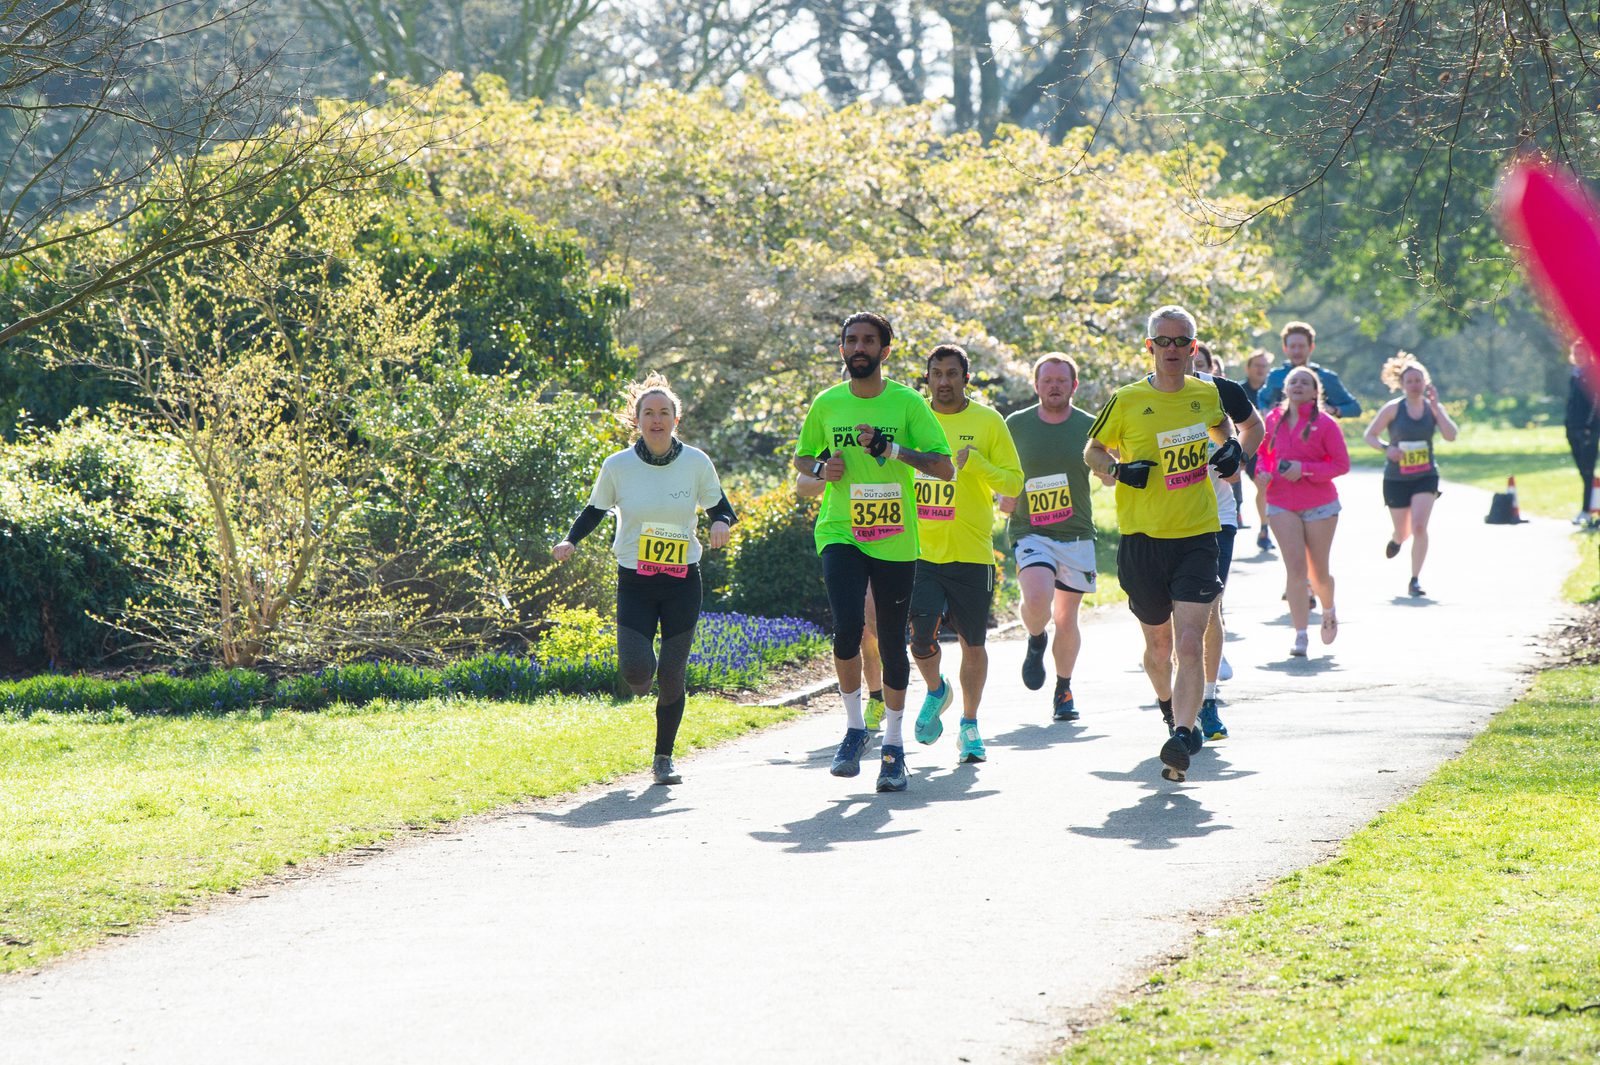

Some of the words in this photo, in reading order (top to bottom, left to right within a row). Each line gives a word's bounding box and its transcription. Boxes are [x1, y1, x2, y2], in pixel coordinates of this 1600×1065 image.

[881, 426, 898, 434] CITY
[1172, 432, 1206, 444] OUTDOORS
[1164, 442, 1206, 473] 2664
[1035, 480, 1066, 489] OUTDOORS
[1169, 475, 1190, 486] KEW
[914, 481, 955, 506] 2019
[1030, 489, 1070, 512] 2076
[853, 502, 901, 525] 3548
[931, 509, 953, 517] HALF
[1052, 509, 1071, 519] HALF
[655, 530, 689, 539] OUTDOORS
[856, 529, 875, 537] KEW
[645, 539, 684, 563] 1921
[641, 564, 662, 572] KEW
